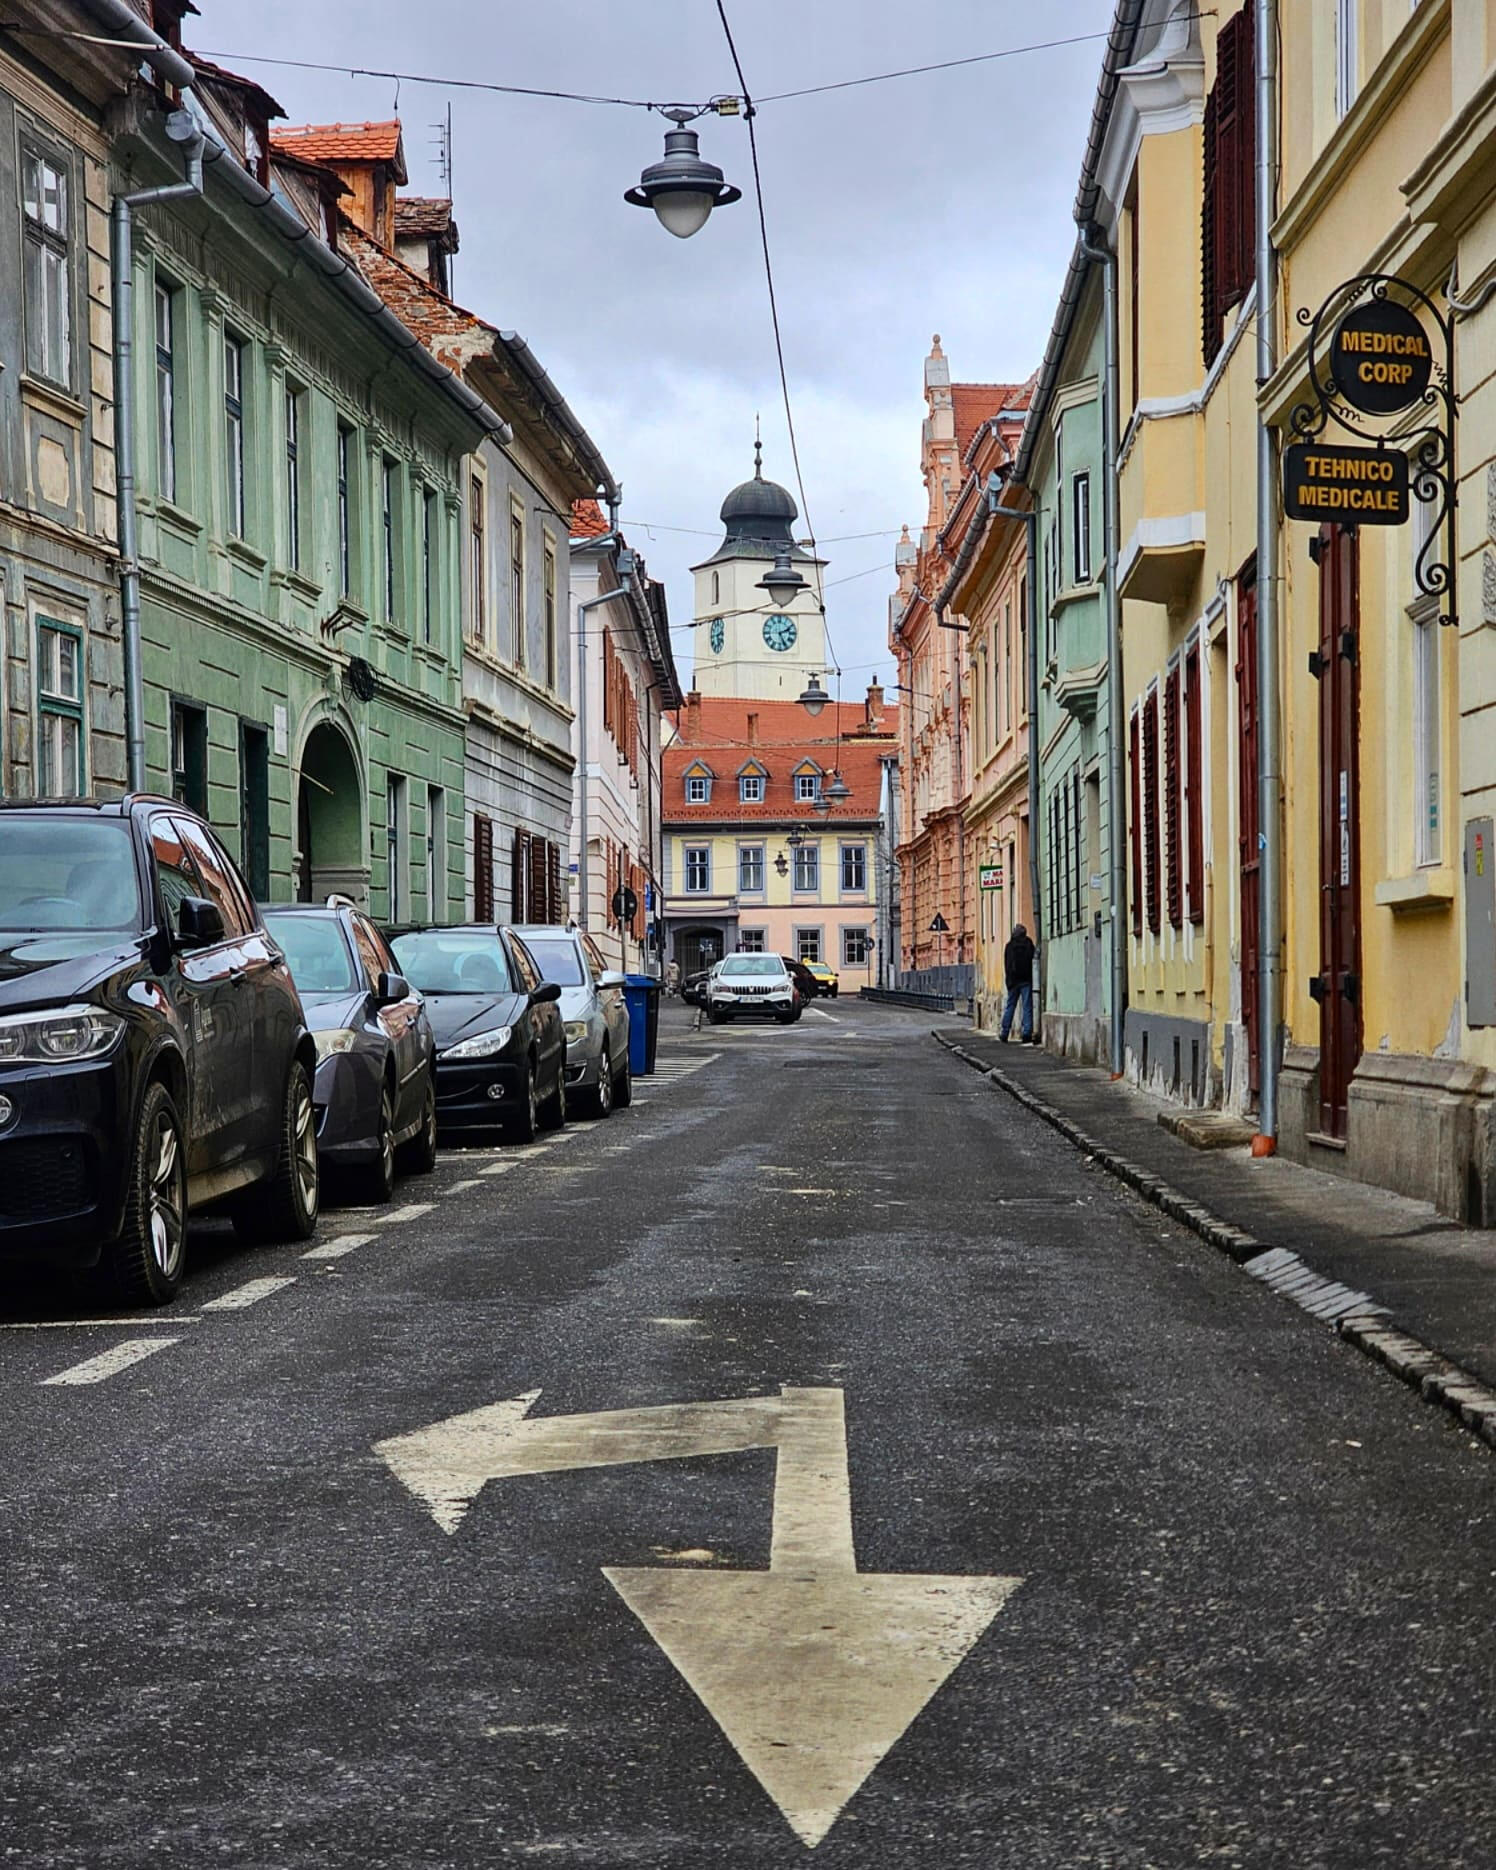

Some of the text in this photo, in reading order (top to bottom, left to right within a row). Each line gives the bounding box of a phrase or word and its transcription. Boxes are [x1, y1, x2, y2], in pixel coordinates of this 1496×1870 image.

[1341, 330, 1429, 358] MEDICAL
[1358, 361, 1413, 385] CORP
[1304, 456, 1394, 482] TEHNICO
[1297, 485, 1400, 511] MEDICALE
